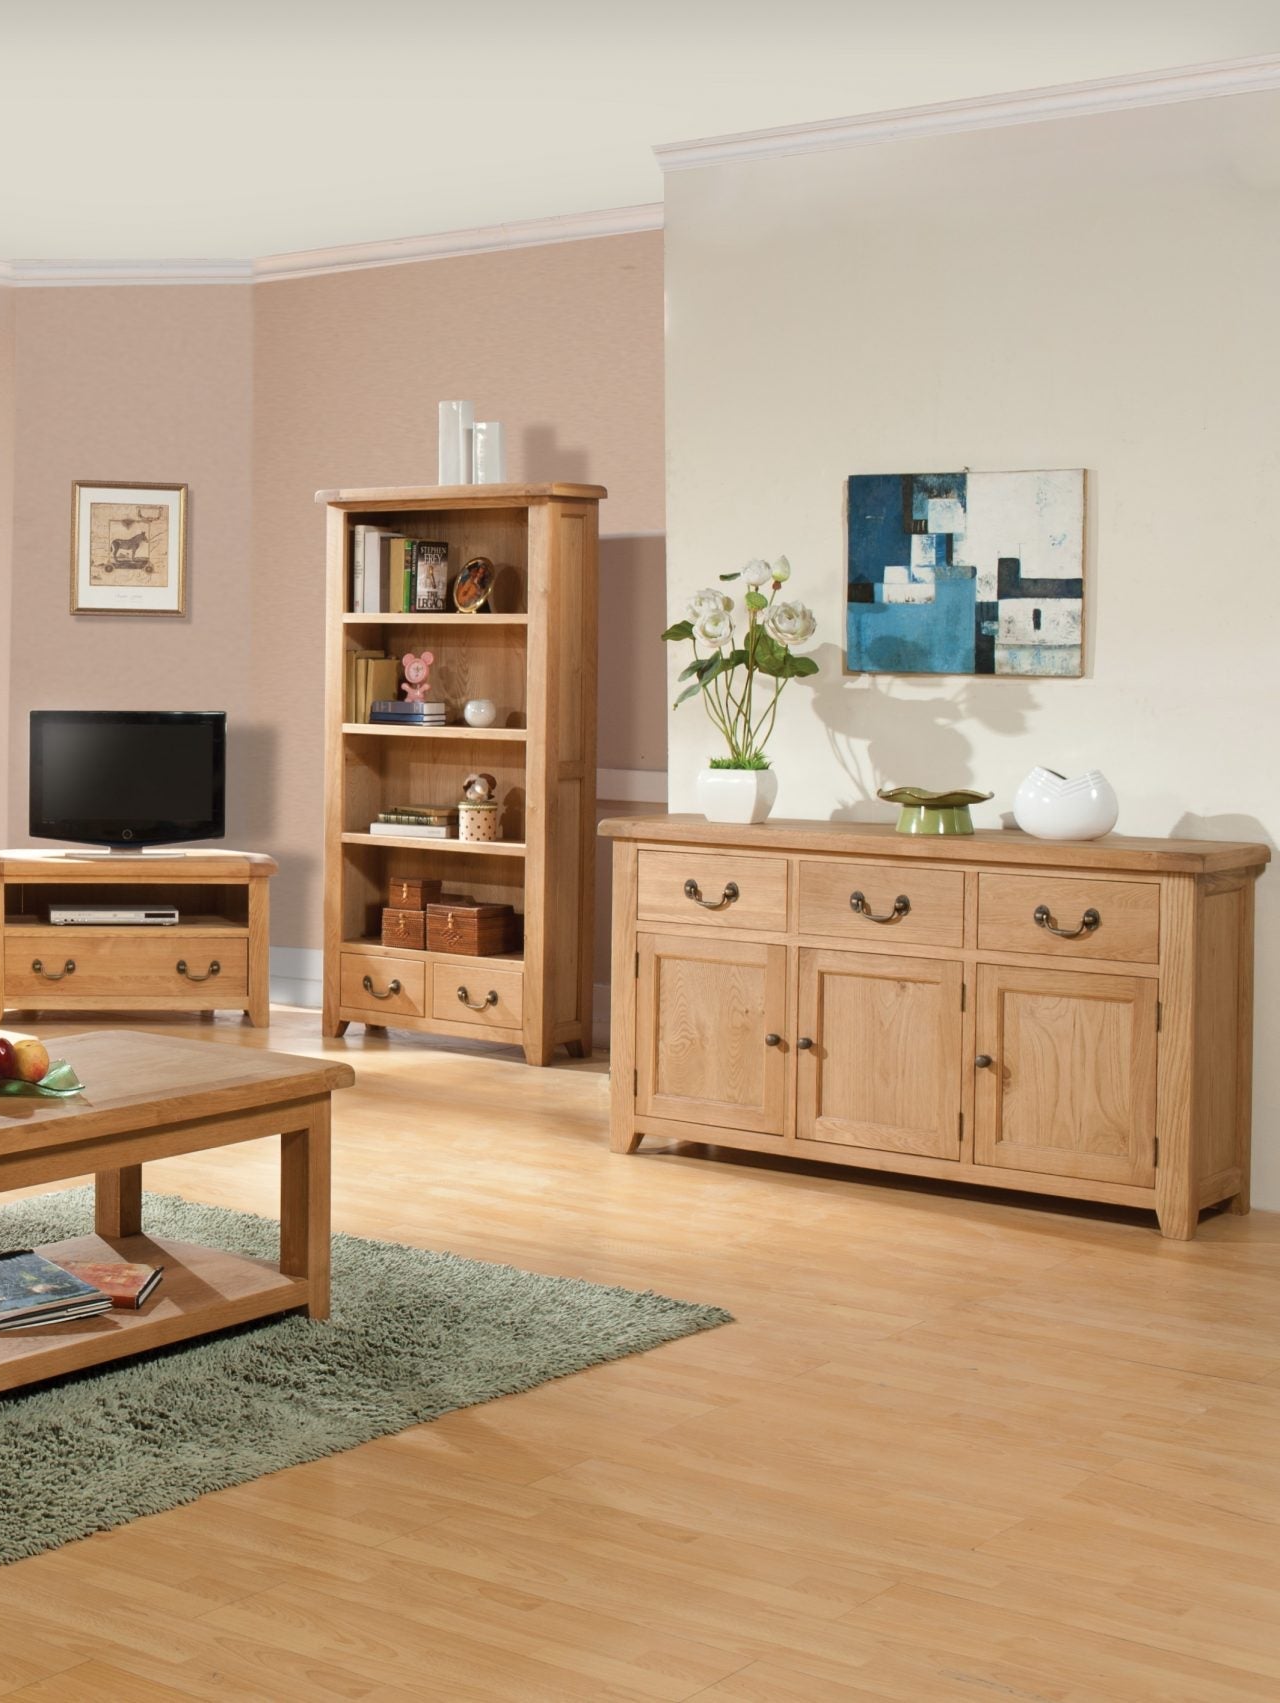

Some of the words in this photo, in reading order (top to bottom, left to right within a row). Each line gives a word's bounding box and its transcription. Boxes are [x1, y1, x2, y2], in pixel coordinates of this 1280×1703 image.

[420, 546, 447, 554] STEPHEN
[423, 553, 443, 564] FREY
[418, 598, 445, 609] LEGACY
